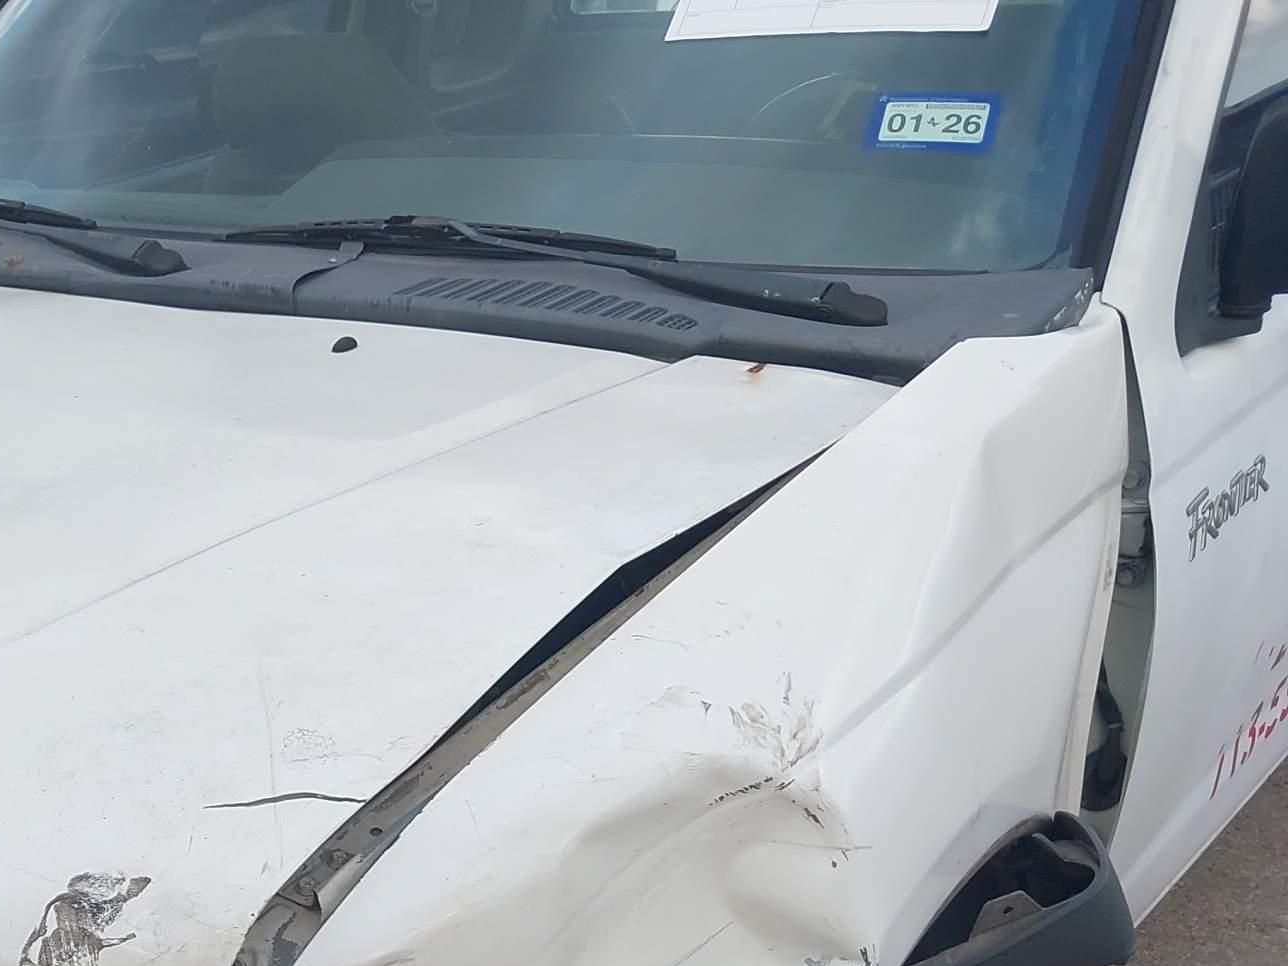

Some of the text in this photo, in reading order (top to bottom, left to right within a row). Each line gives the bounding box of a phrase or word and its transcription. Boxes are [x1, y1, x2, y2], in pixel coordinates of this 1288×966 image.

[886, 112, 983, 134] 01 26
[1185, 454, 1269, 562] FRONTIER
